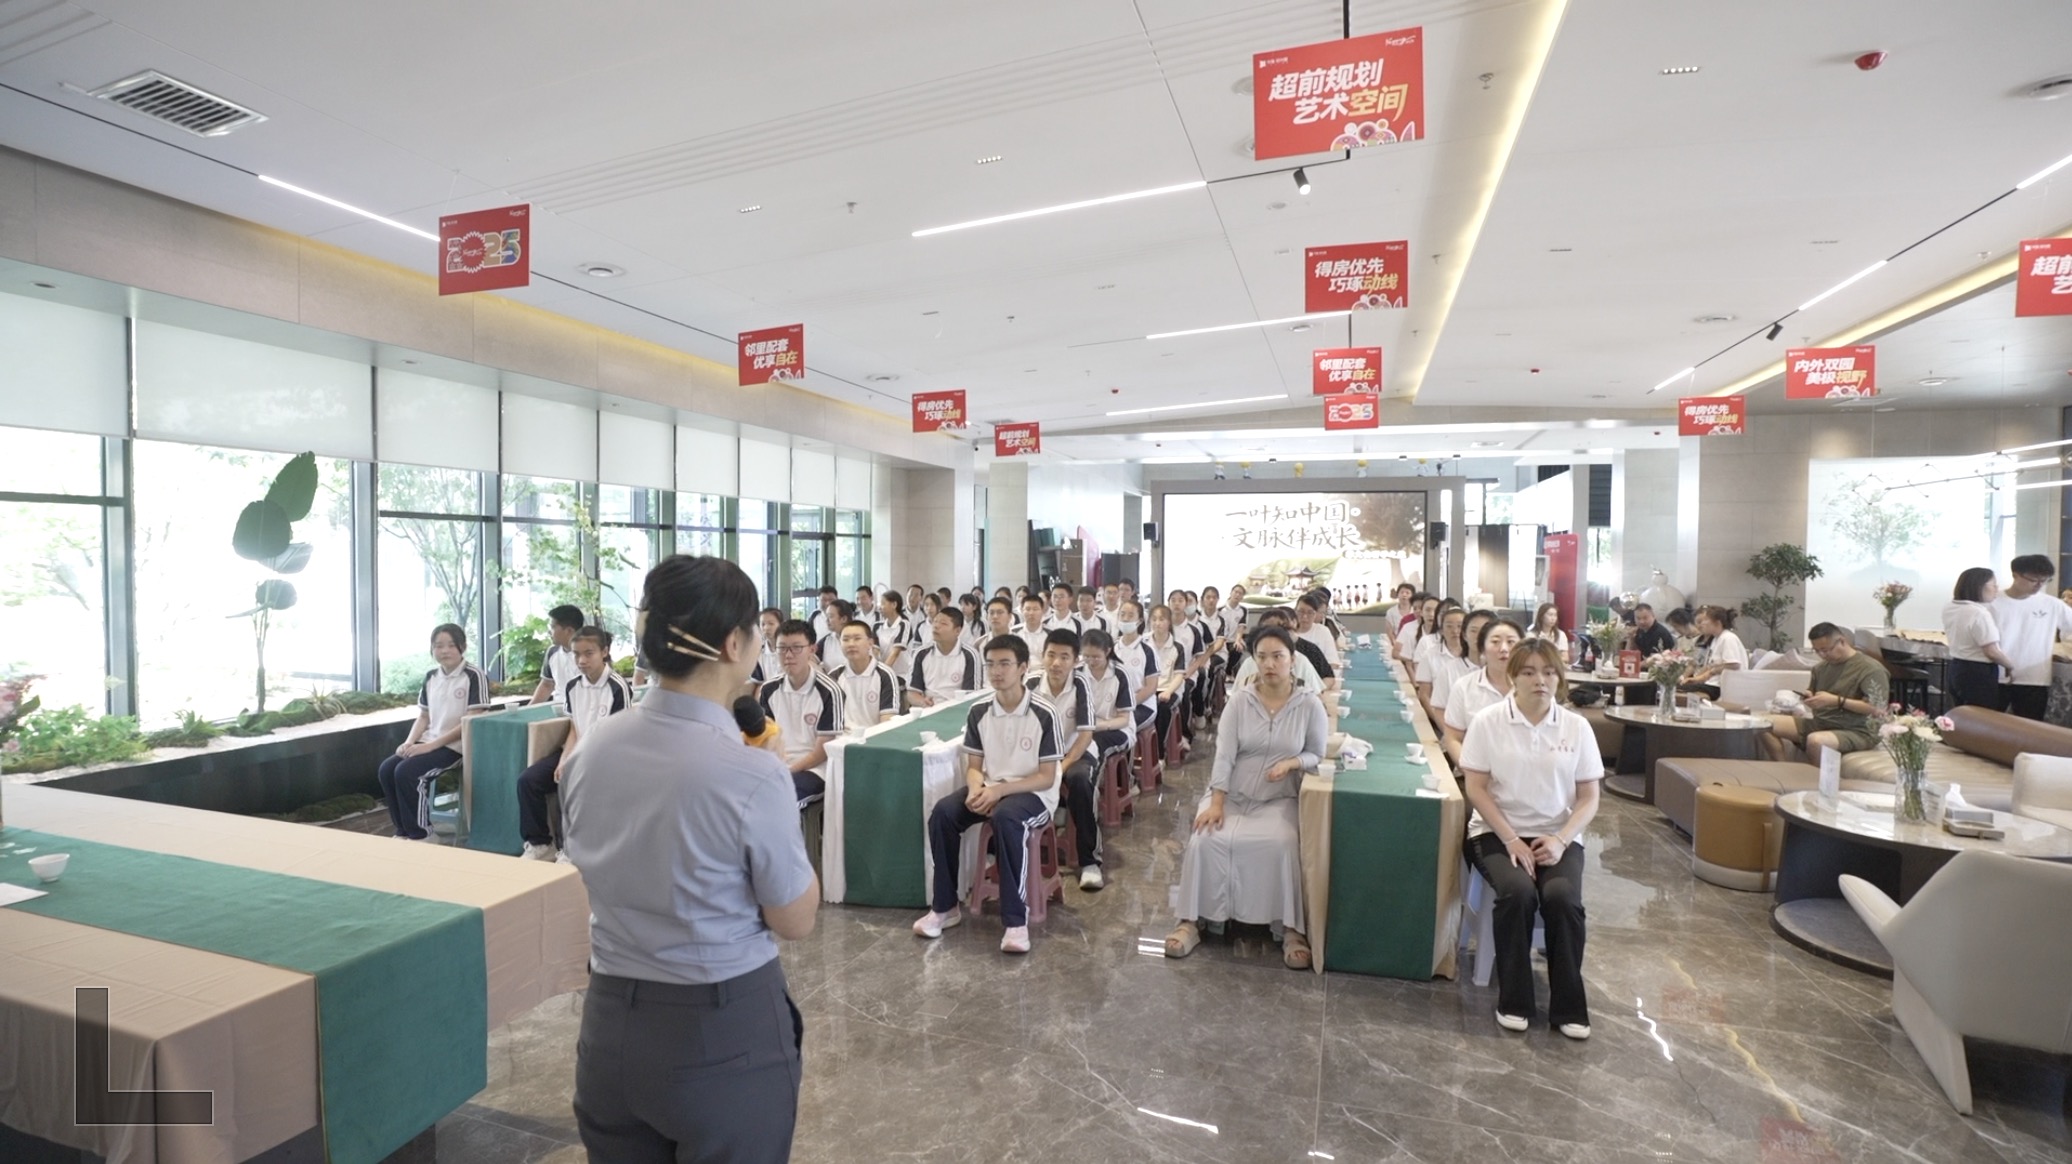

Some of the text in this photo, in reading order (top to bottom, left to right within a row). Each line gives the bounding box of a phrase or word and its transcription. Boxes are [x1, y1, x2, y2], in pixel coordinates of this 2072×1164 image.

[1268, 58, 1384, 102] 超前规划
[1292, 83, 1409, 125] 艺术空间
[446, 228, 522, 274] 2025
[1314, 257, 1384, 279] 得房优先
[1328, 273, 1399, 295] 巧琢动线
[745, 339, 789, 357] 邻里配套
[754, 351, 798, 369] 优享自在
[1319, 358, 1367, 372] 邻里配套
[1328, 368, 1376, 382] 优享自在
[1328, 403, 1374, 422] 2025
[1225, 502, 1347, 525] 一叶知中国
[1233, 525, 1360, 551] 文脉伴成长
